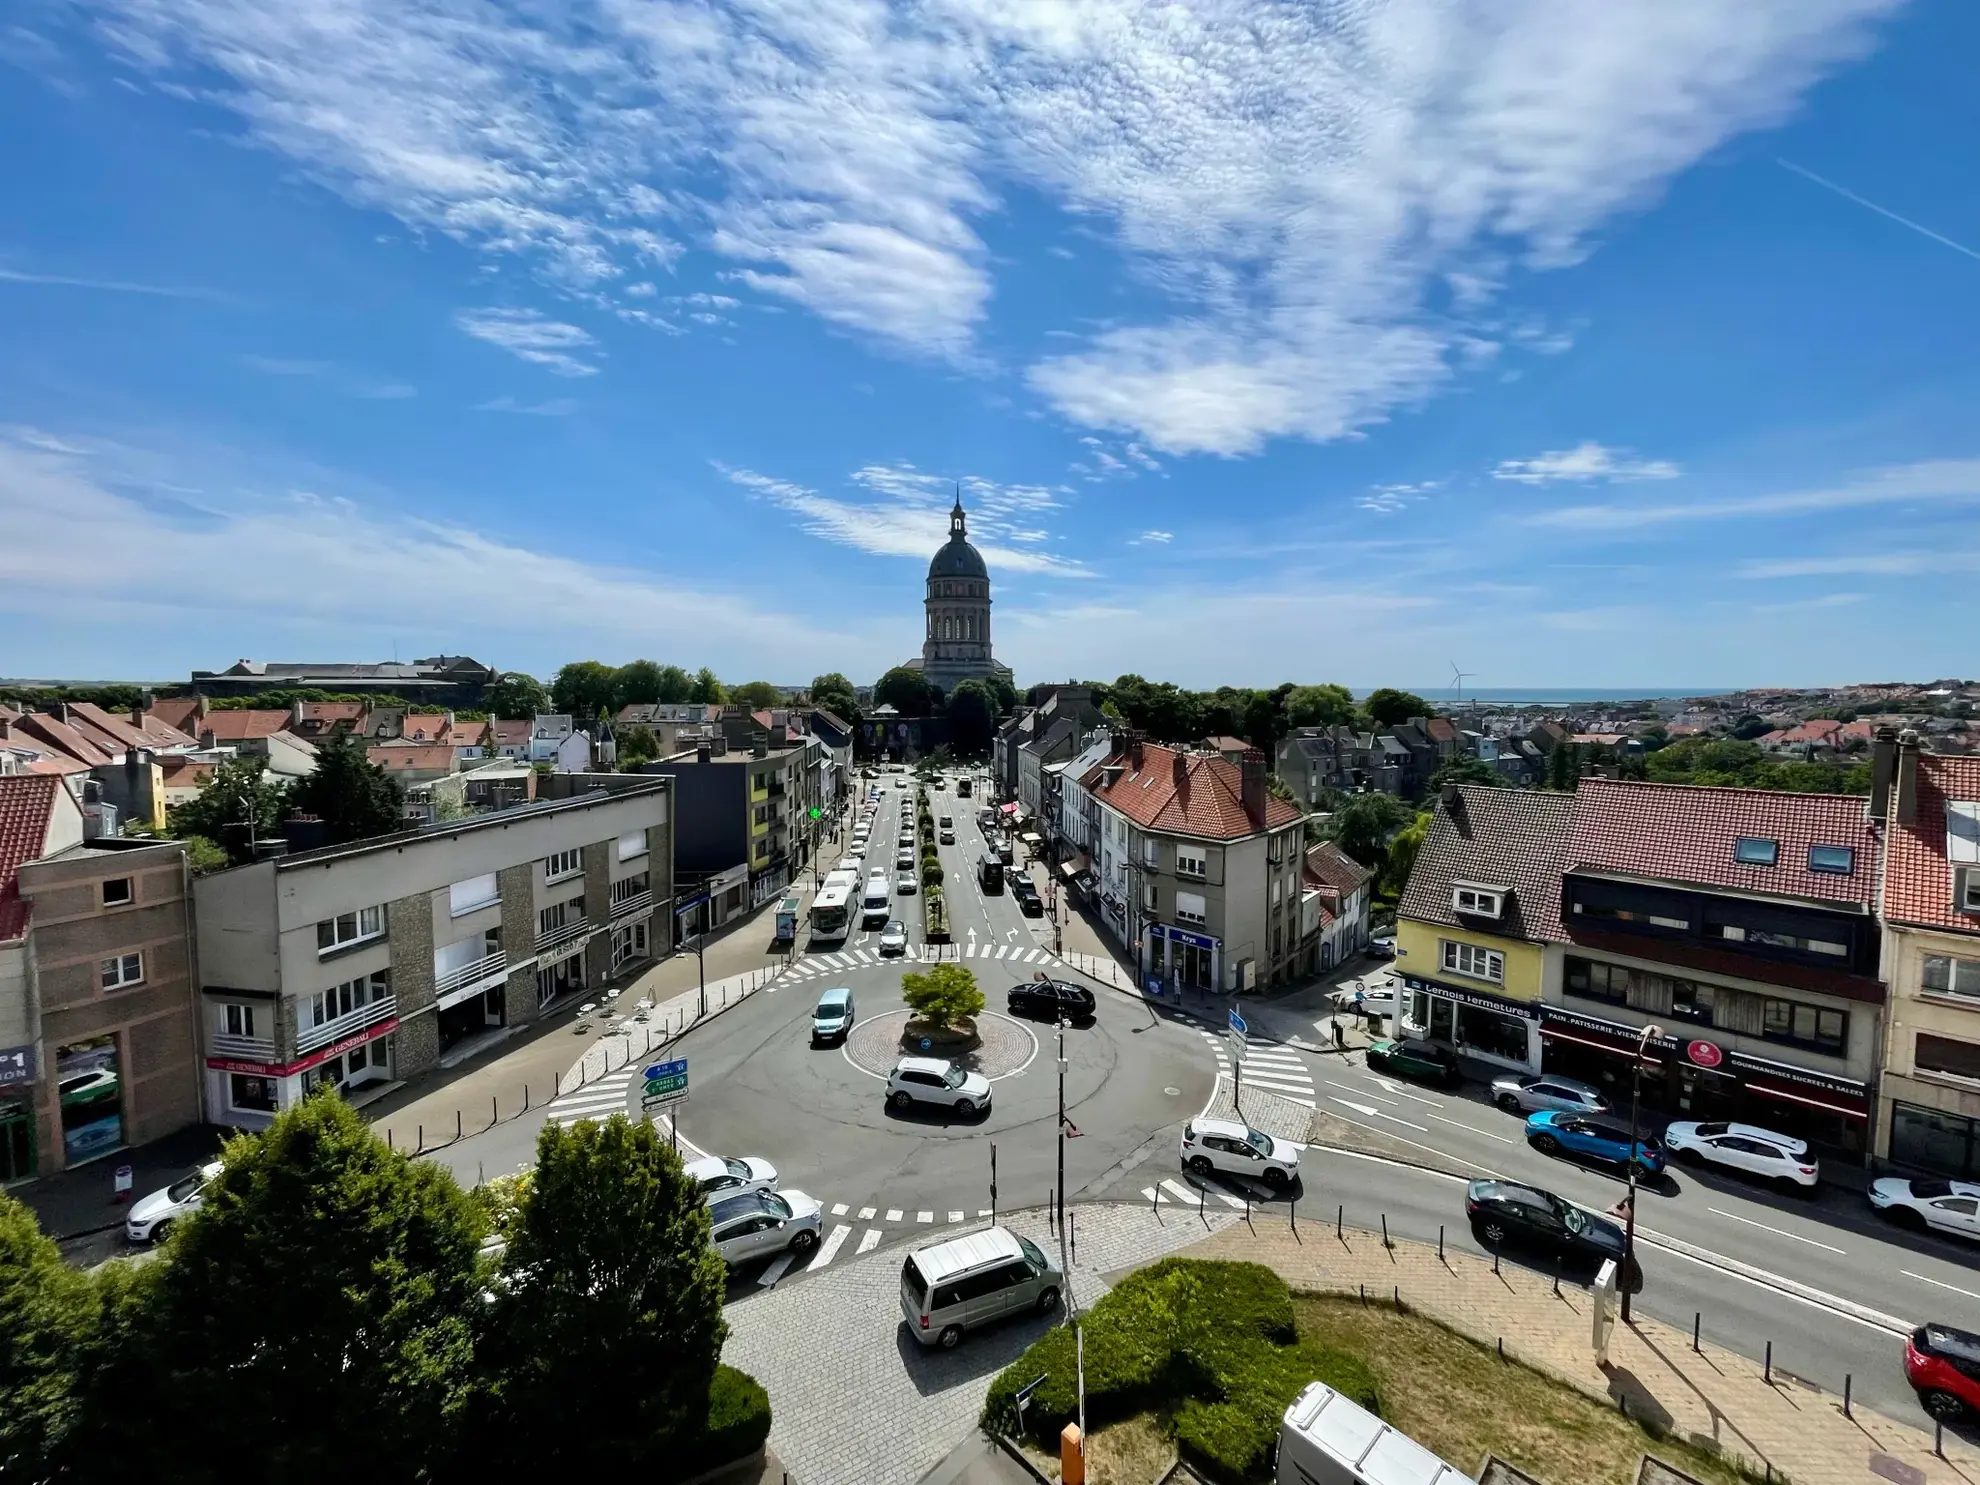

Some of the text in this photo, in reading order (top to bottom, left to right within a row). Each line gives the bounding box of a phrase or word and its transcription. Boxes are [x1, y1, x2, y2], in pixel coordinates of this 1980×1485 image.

[1182, 934, 1197, 944] Krys
[1548, 1013, 1566, 1022] PAIN
[1571, 1018, 1613, 1035] PATISSERIE
[334, 1032, 370, 1053] GENERALI
[235, 1063, 267, 1074] GENERALI
[1731, 1059, 1791, 1079] GOURMANDISES
[1792, 1074, 1826, 1088] SUCREES
[1835, 1085, 1865, 1097] SALEES
